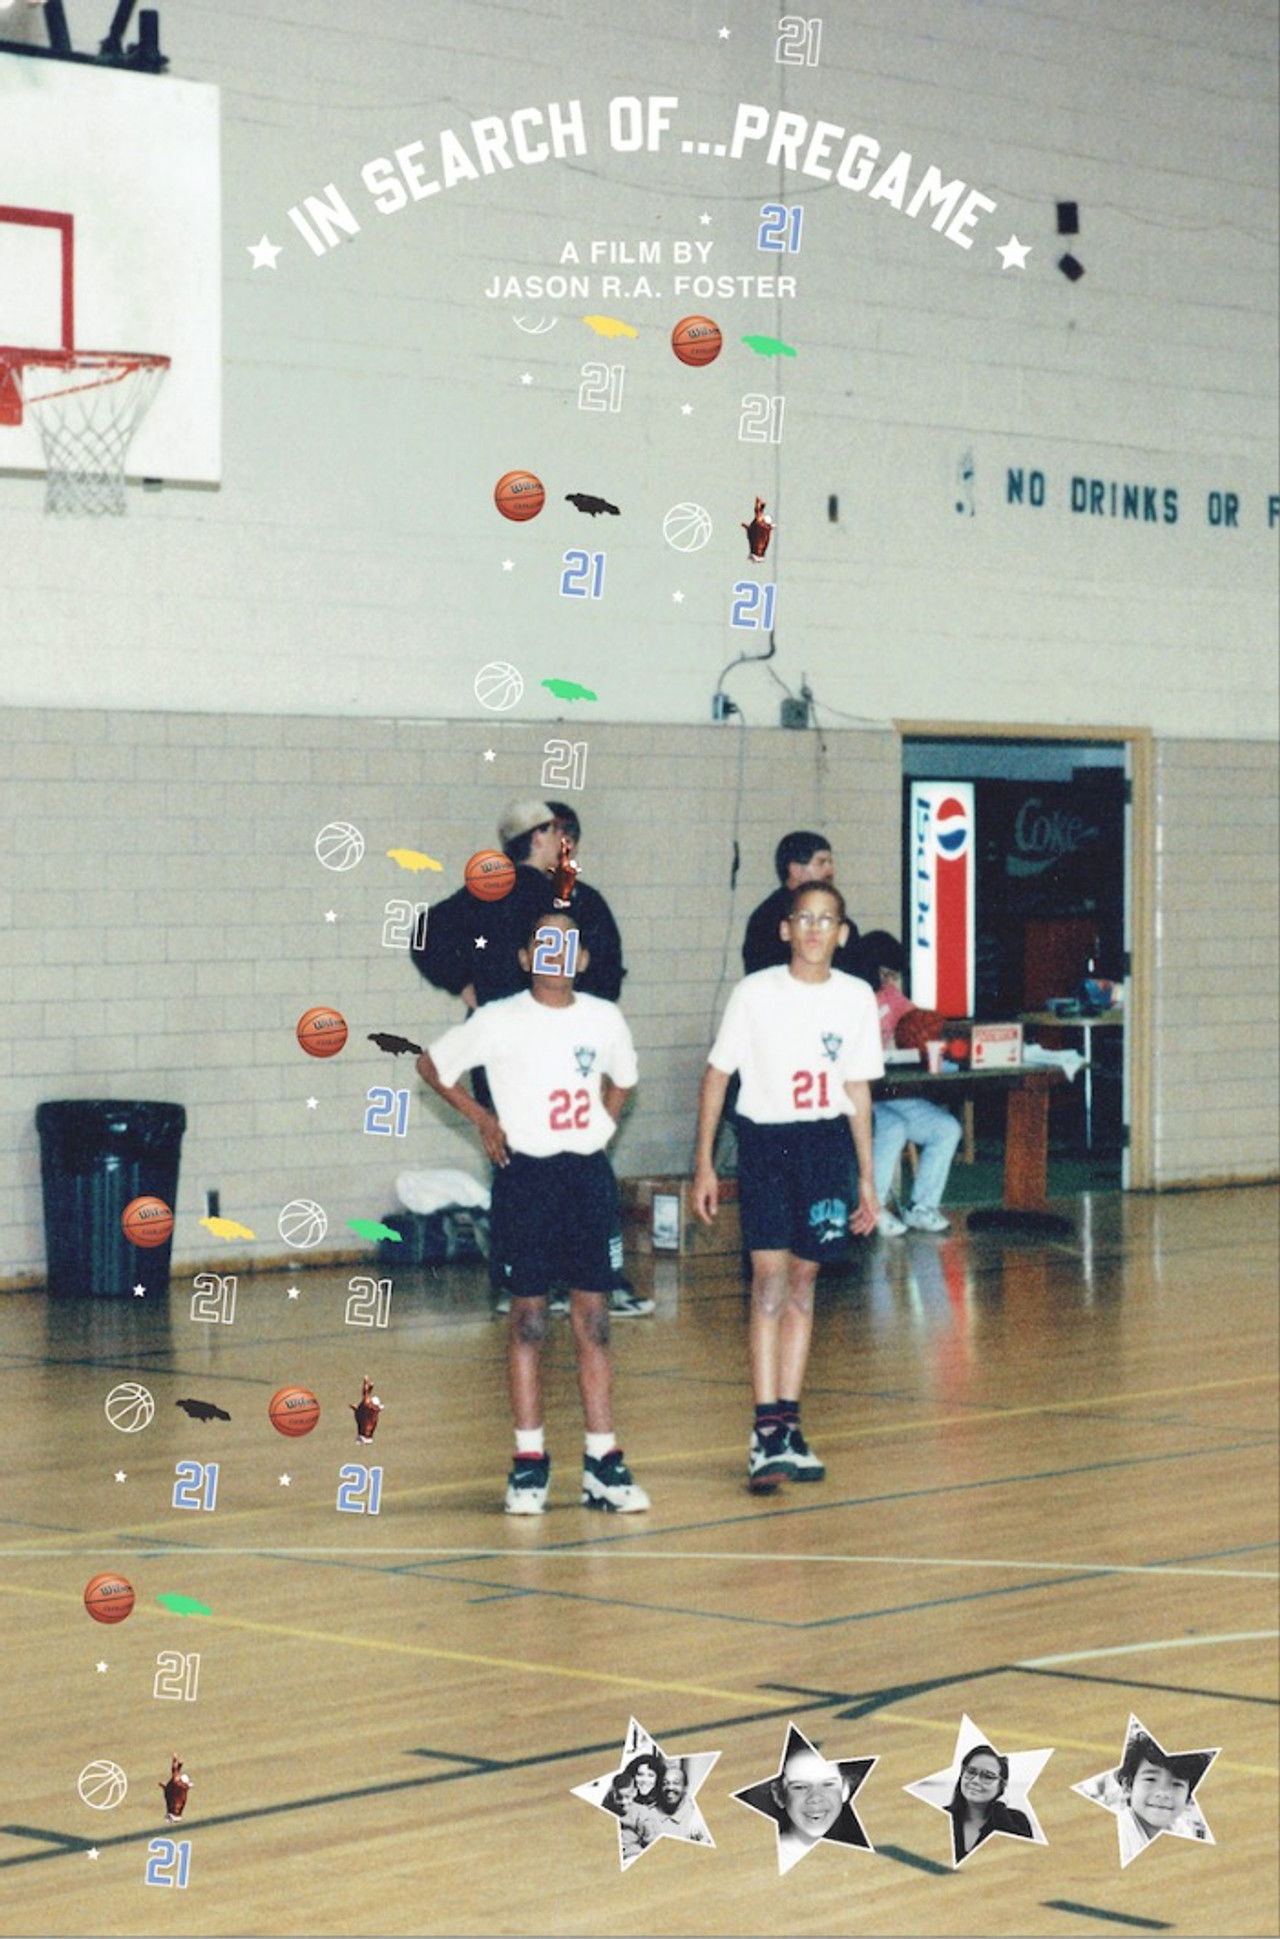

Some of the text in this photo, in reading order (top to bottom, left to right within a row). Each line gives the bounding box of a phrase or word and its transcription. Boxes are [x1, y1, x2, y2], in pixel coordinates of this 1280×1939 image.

[1007, 467, 1045, 507] NO
[1071, 476, 1178, 524] DRINKS
[1208, 491, 1239, 528] OR
[549, 1088, 590, 1130] 22
[792, 1070, 829, 1109] 21
